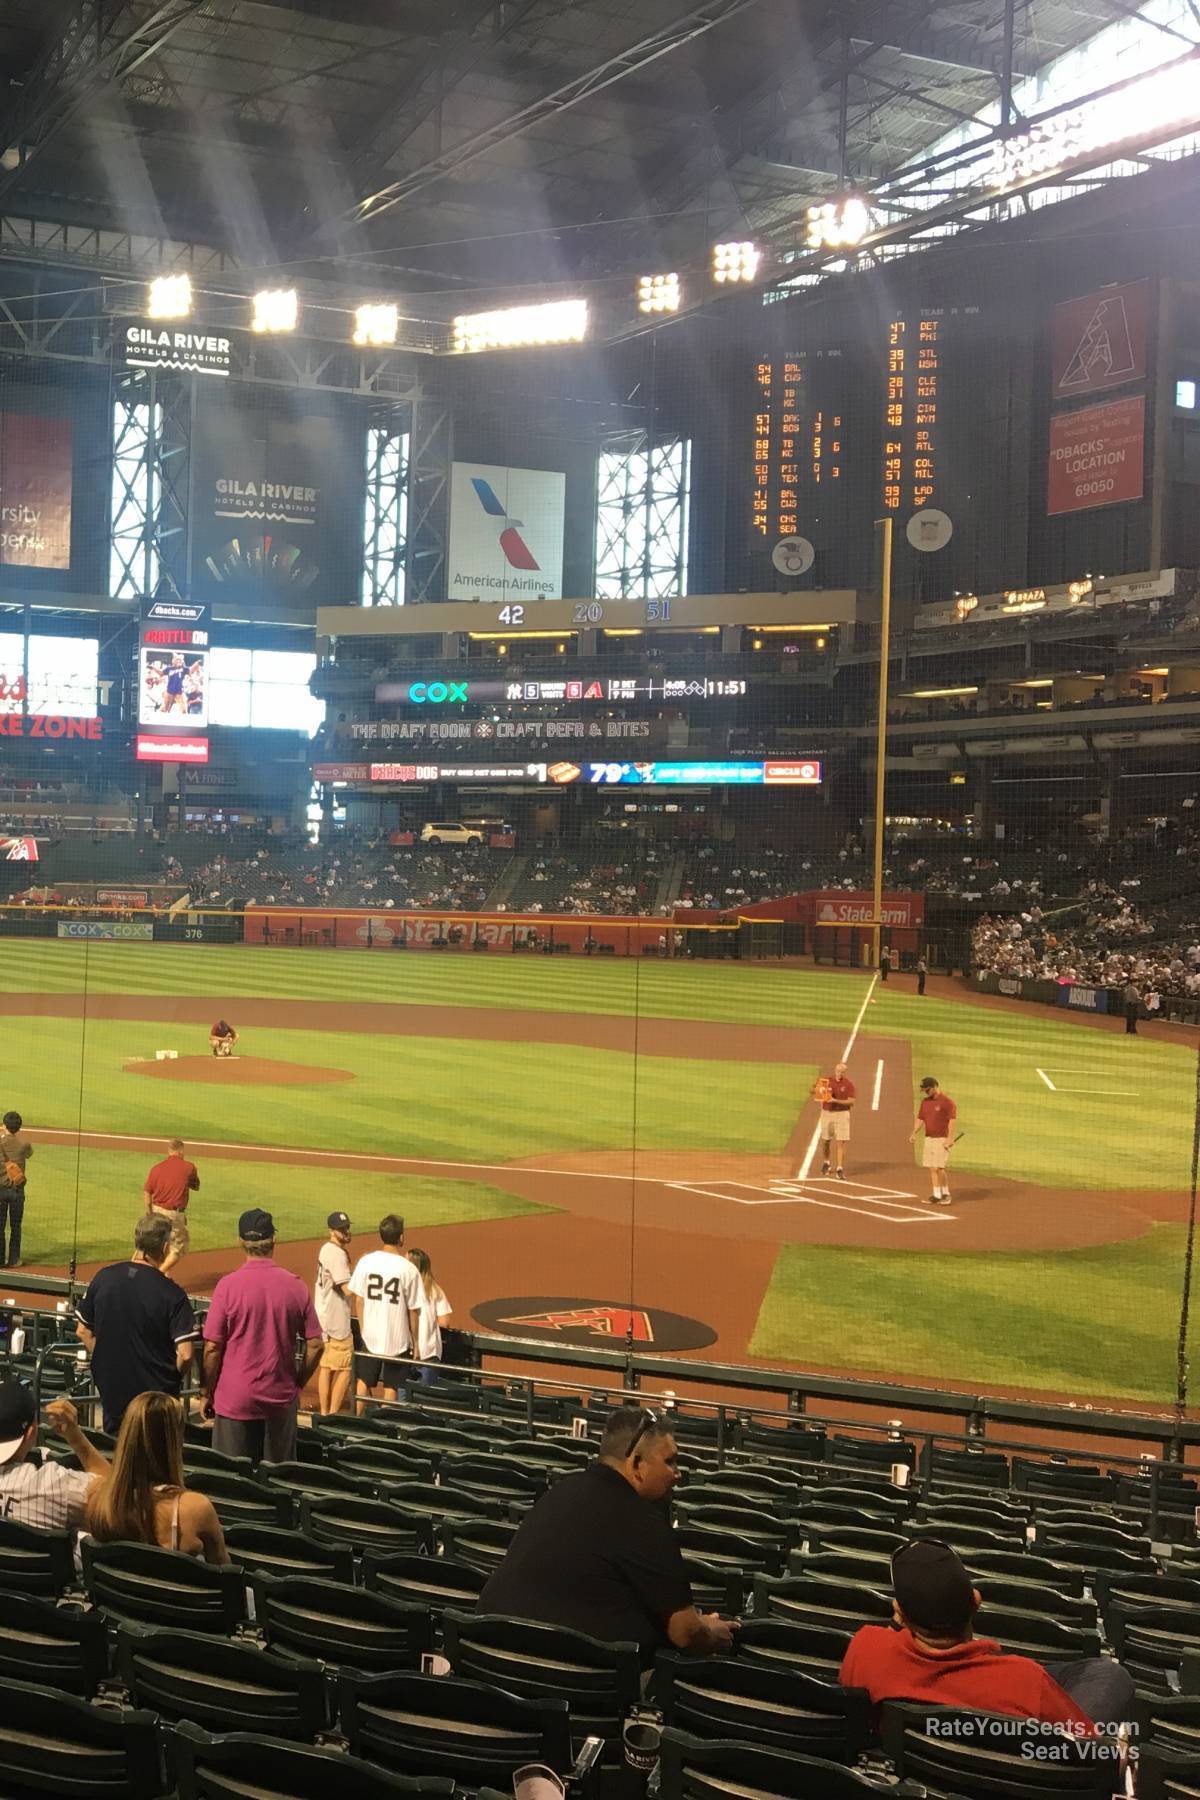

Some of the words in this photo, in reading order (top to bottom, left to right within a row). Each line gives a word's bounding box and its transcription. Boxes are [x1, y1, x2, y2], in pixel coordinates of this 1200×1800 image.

[920, 321, 938, 331] DET
[126, 327, 170, 346] GILA
[174, 333, 231, 353] RIVER
[126, 346, 168, 357] HOTELS
[184, 352, 230, 364] CASINOS
[1065, 449, 1126, 474] LOCATION
[215, 479, 257, 496] GILA
[261, 483, 317, 502] RIVER
[1075, 478, 1114, 497] 69050
[215, 498, 255, 508] HOTELS
[271, 502, 316, 513] CASINOS
[780, 515, 797, 523] CHC
[453, 573, 510, 589] American
[511, 578, 554, 593] Airlines
[155, 606, 197, 617] dbacks.com
[498, 605, 524, 624] 42
[573, 602, 602, 622] 20
[647, 600, 671, 621] 51
[409, 682, 468, 703] COX
[708, 681, 746, 695] 11:51
[29, 714, 104, 739] ZONE
[352, 724, 377, 738] THE
[496, 722, 543, 738] CRAFT
[589, 723, 602, 736] &
[607, 721, 650, 737] BITES
[839, 904, 873, 922] State
[876, 906, 907, 924] arm
[69, 924, 97, 935] COX
[113, 925, 141, 936] COX
[185, 929, 202, 940] 376
[367, 1273, 400, 1305] 24
